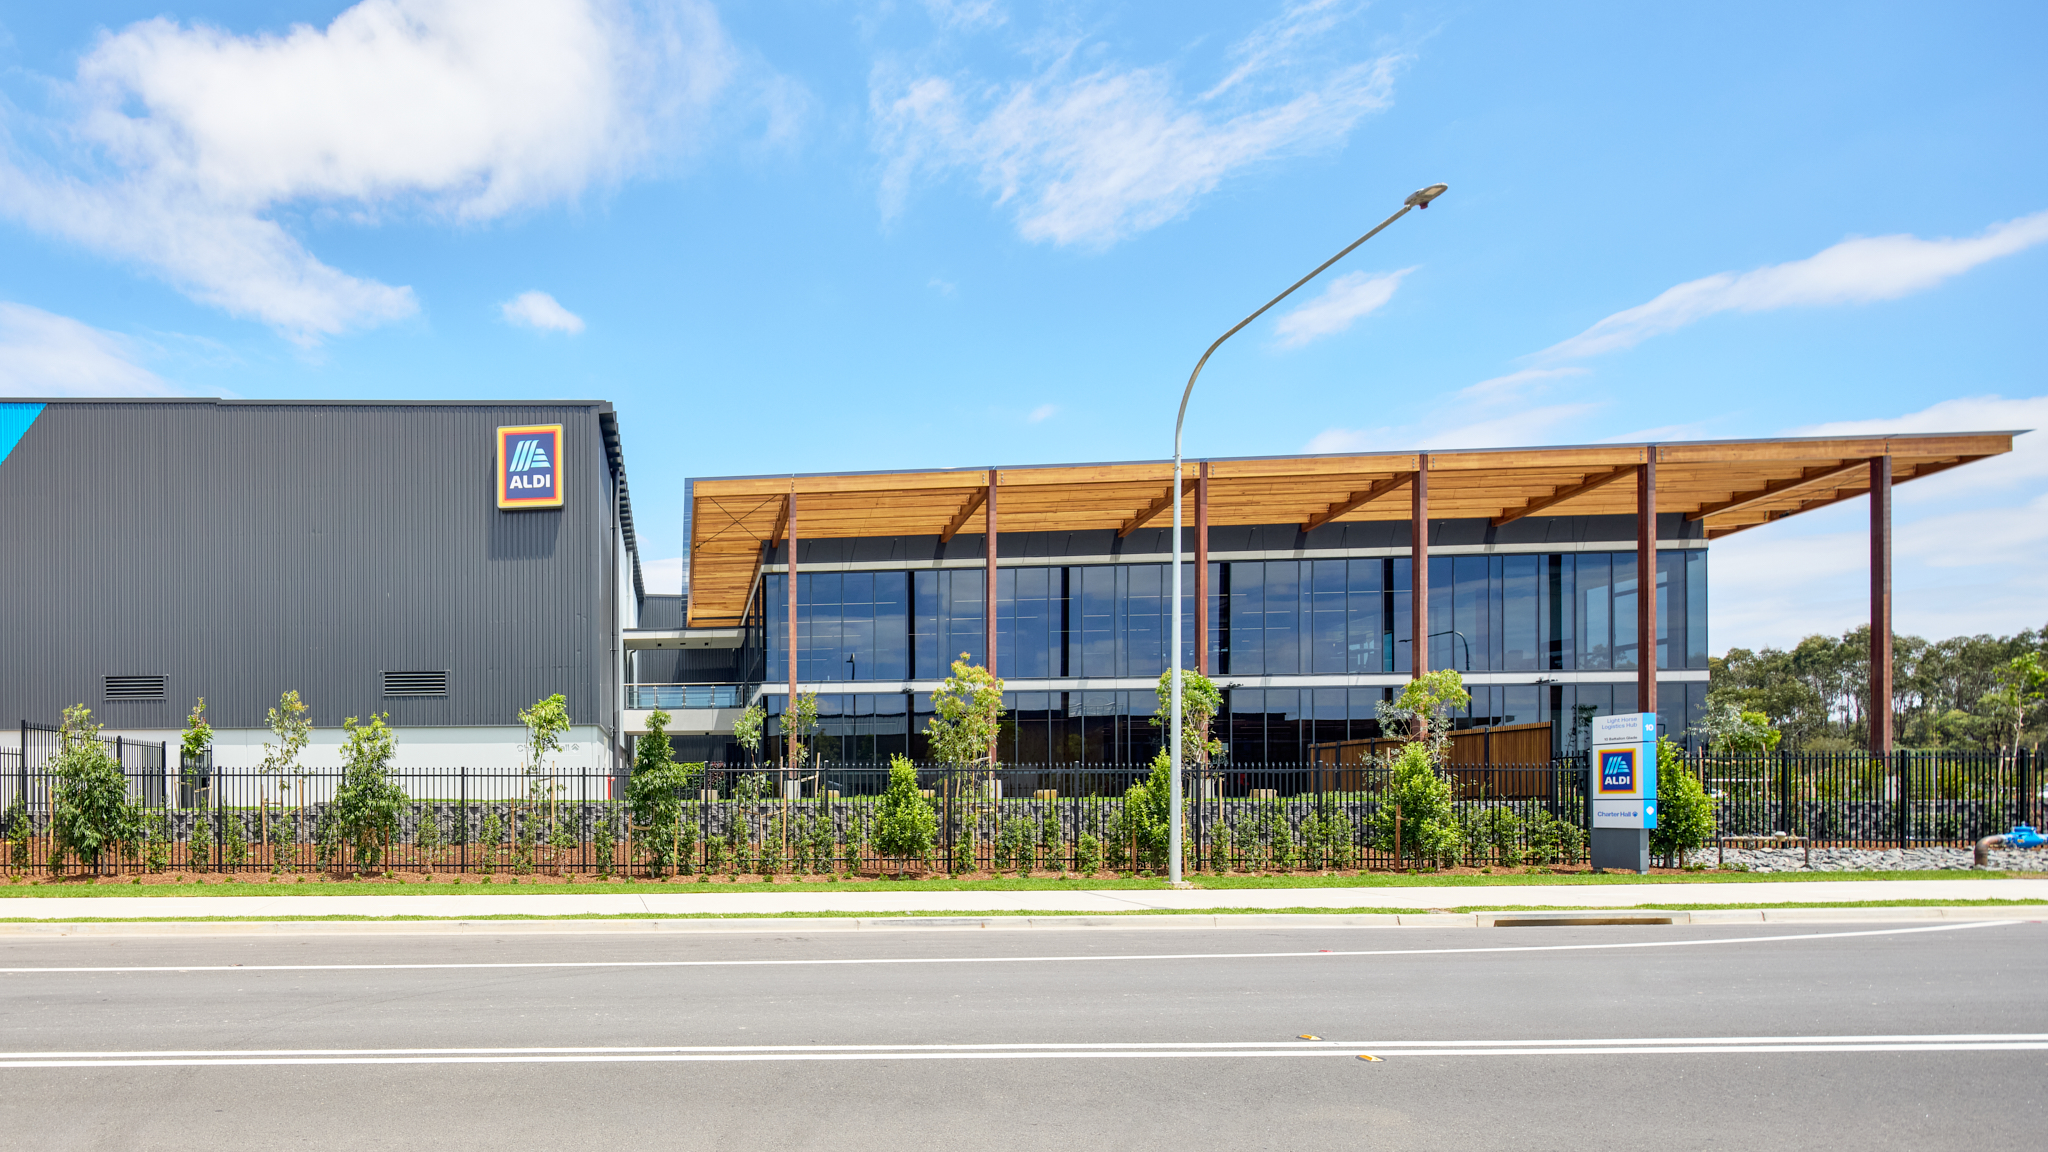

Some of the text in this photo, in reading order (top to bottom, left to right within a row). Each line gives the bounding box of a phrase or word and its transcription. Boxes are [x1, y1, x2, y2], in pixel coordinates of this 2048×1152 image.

[509, 474, 551, 489] ALDI
[1607, 717, 1620, 725] Light
[1604, 776, 1630, 785] ALDI
